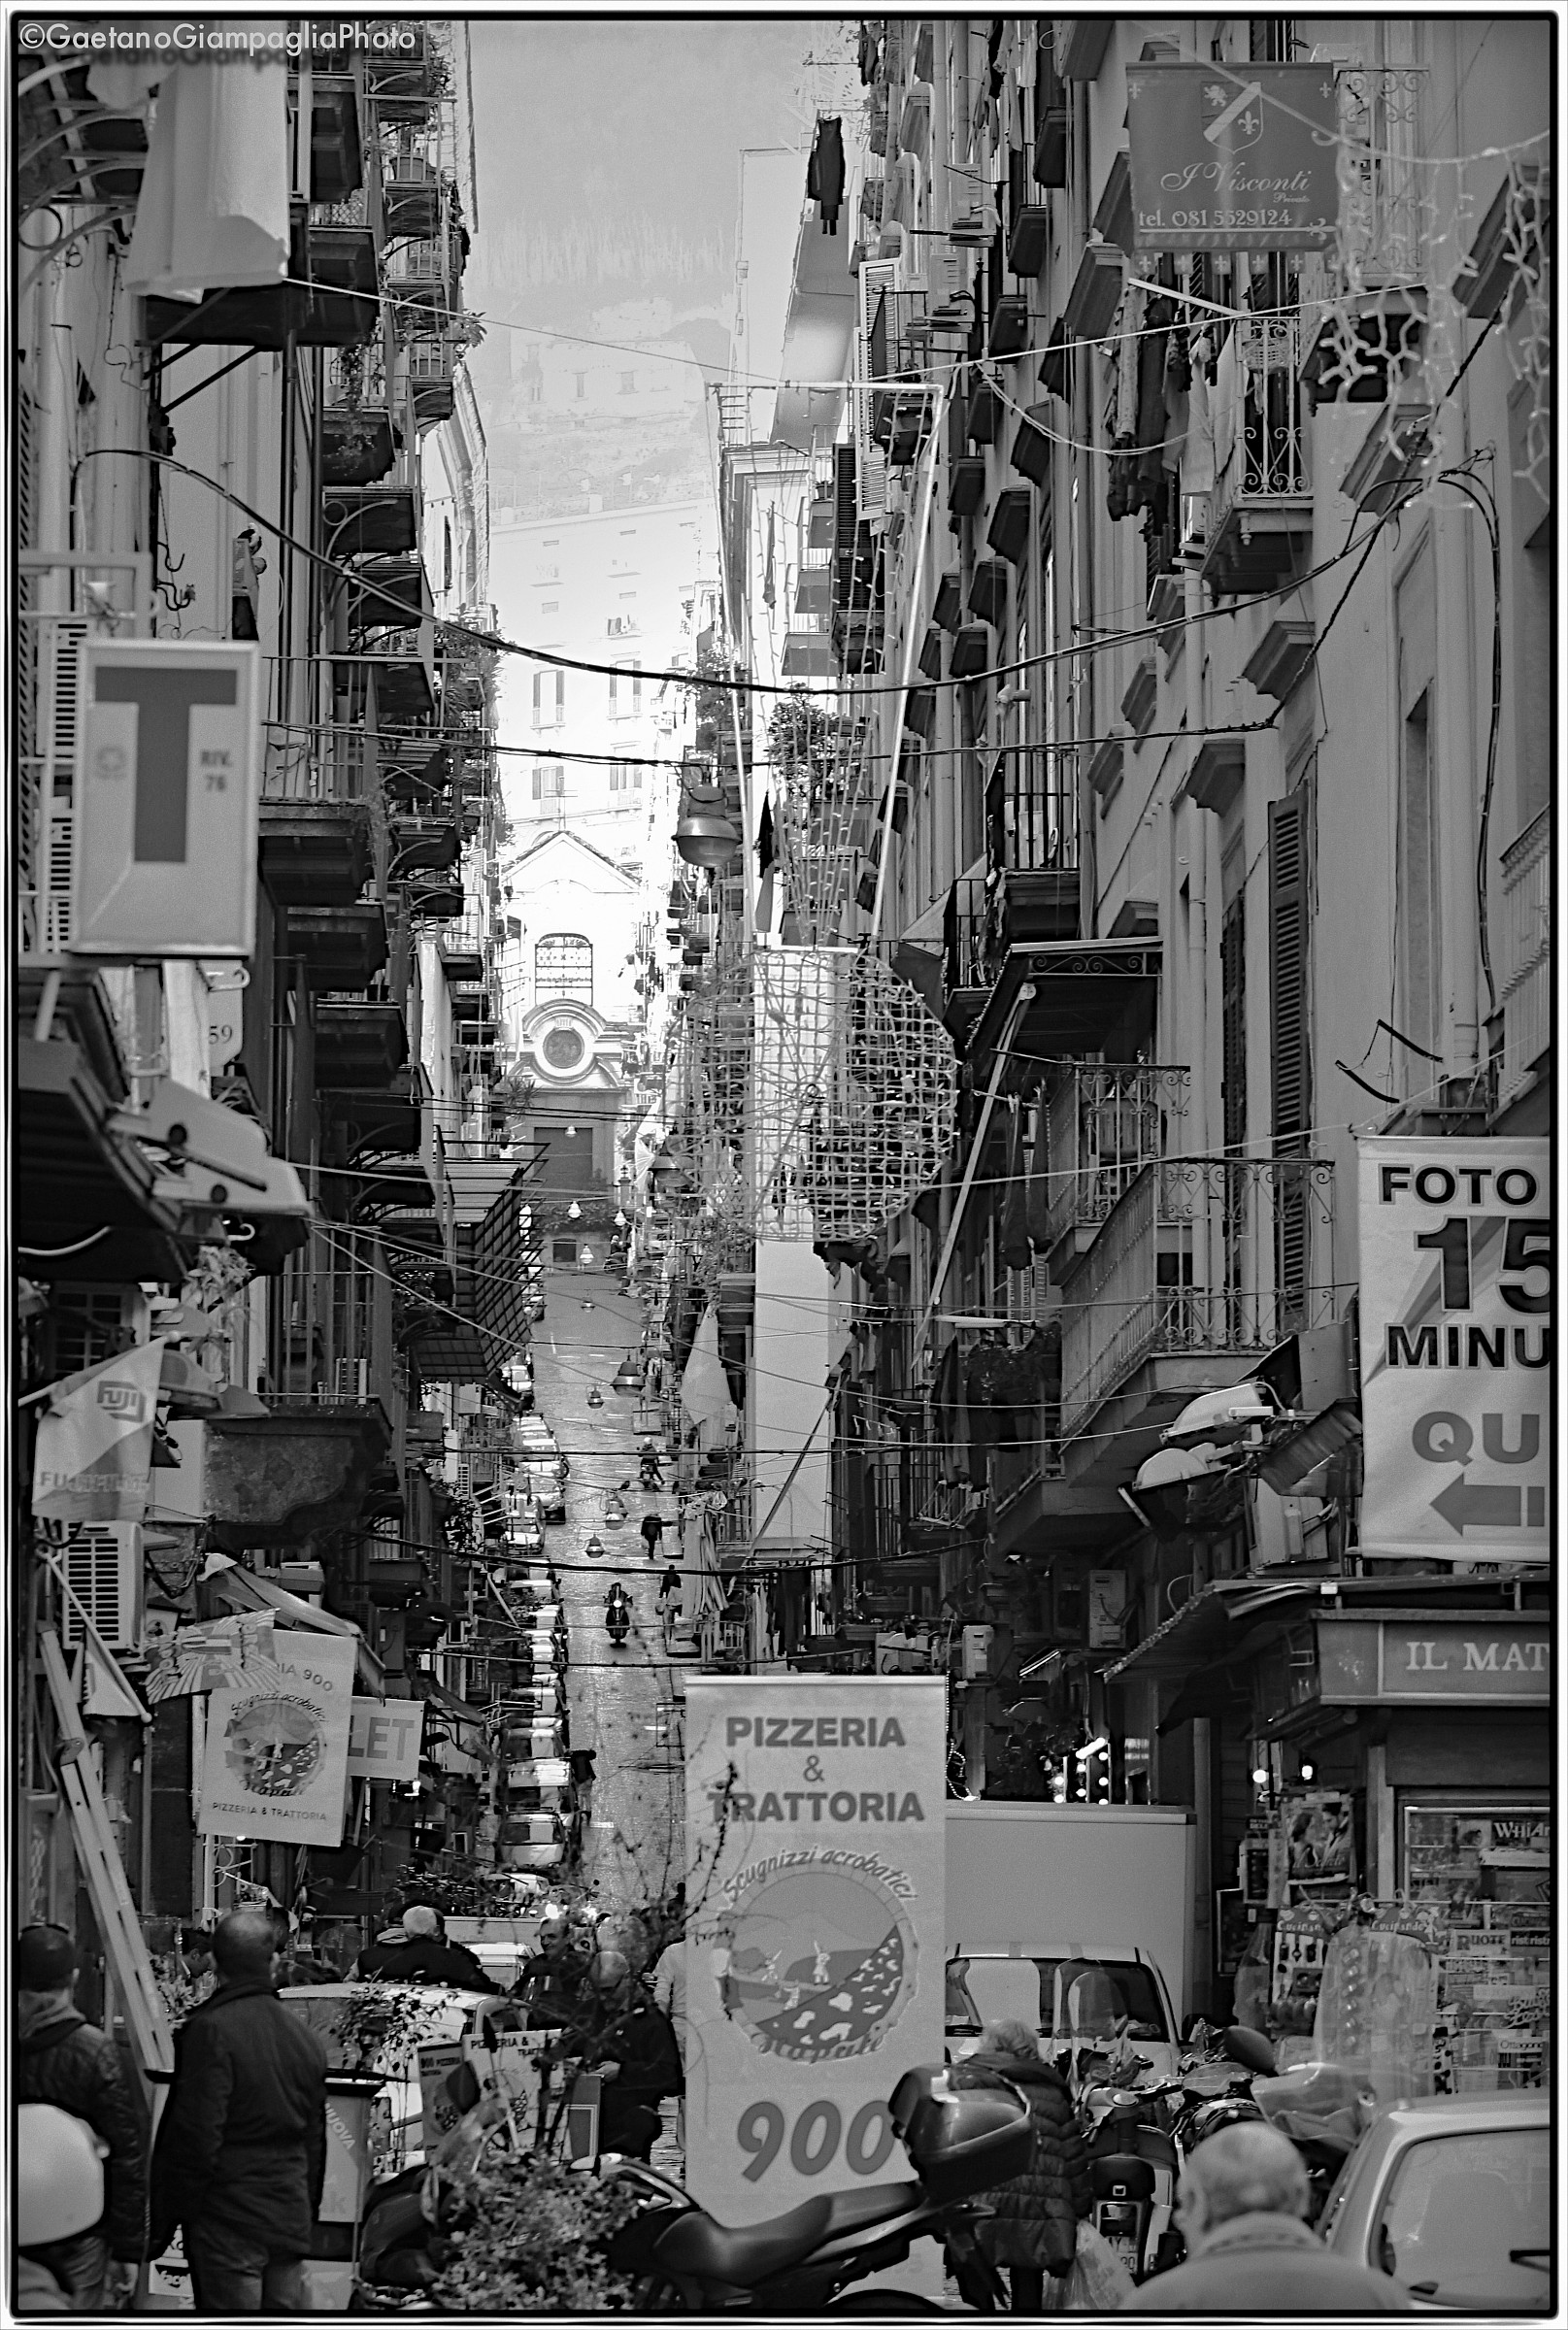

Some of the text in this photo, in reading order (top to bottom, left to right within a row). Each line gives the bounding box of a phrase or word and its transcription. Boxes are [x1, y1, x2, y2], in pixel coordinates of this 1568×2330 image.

[1202, 161, 1312, 192] Visconti
[1139, 208, 1292, 227] tel. 081 5529124
[95, 666, 237, 862] T
[1379, 1164, 1539, 1206] FOTO
[1414, 1215, 1550, 1314] 15
[1385, 1323, 1550, 1370] MINU
[1412, 1411, 1540, 1466] QU
[1406, 1641, 1550, 1672] IL MAT
[302, 1668, 333, 1692] 900
[726, 1716, 906, 1748] PIZZERIA
[803, 1754, 825, 1782] &
[213, 1802, 257, 1815] PIZZERIA
[271, 1807, 327, 1821] TRATTORIA
[707, 1791, 925, 1822] TRATTORIA
[722, 1845, 917, 1902] Scugnizzi acrobatici
[521, 2036, 529, 2047] &
[737, 2100, 897, 2182] 900
